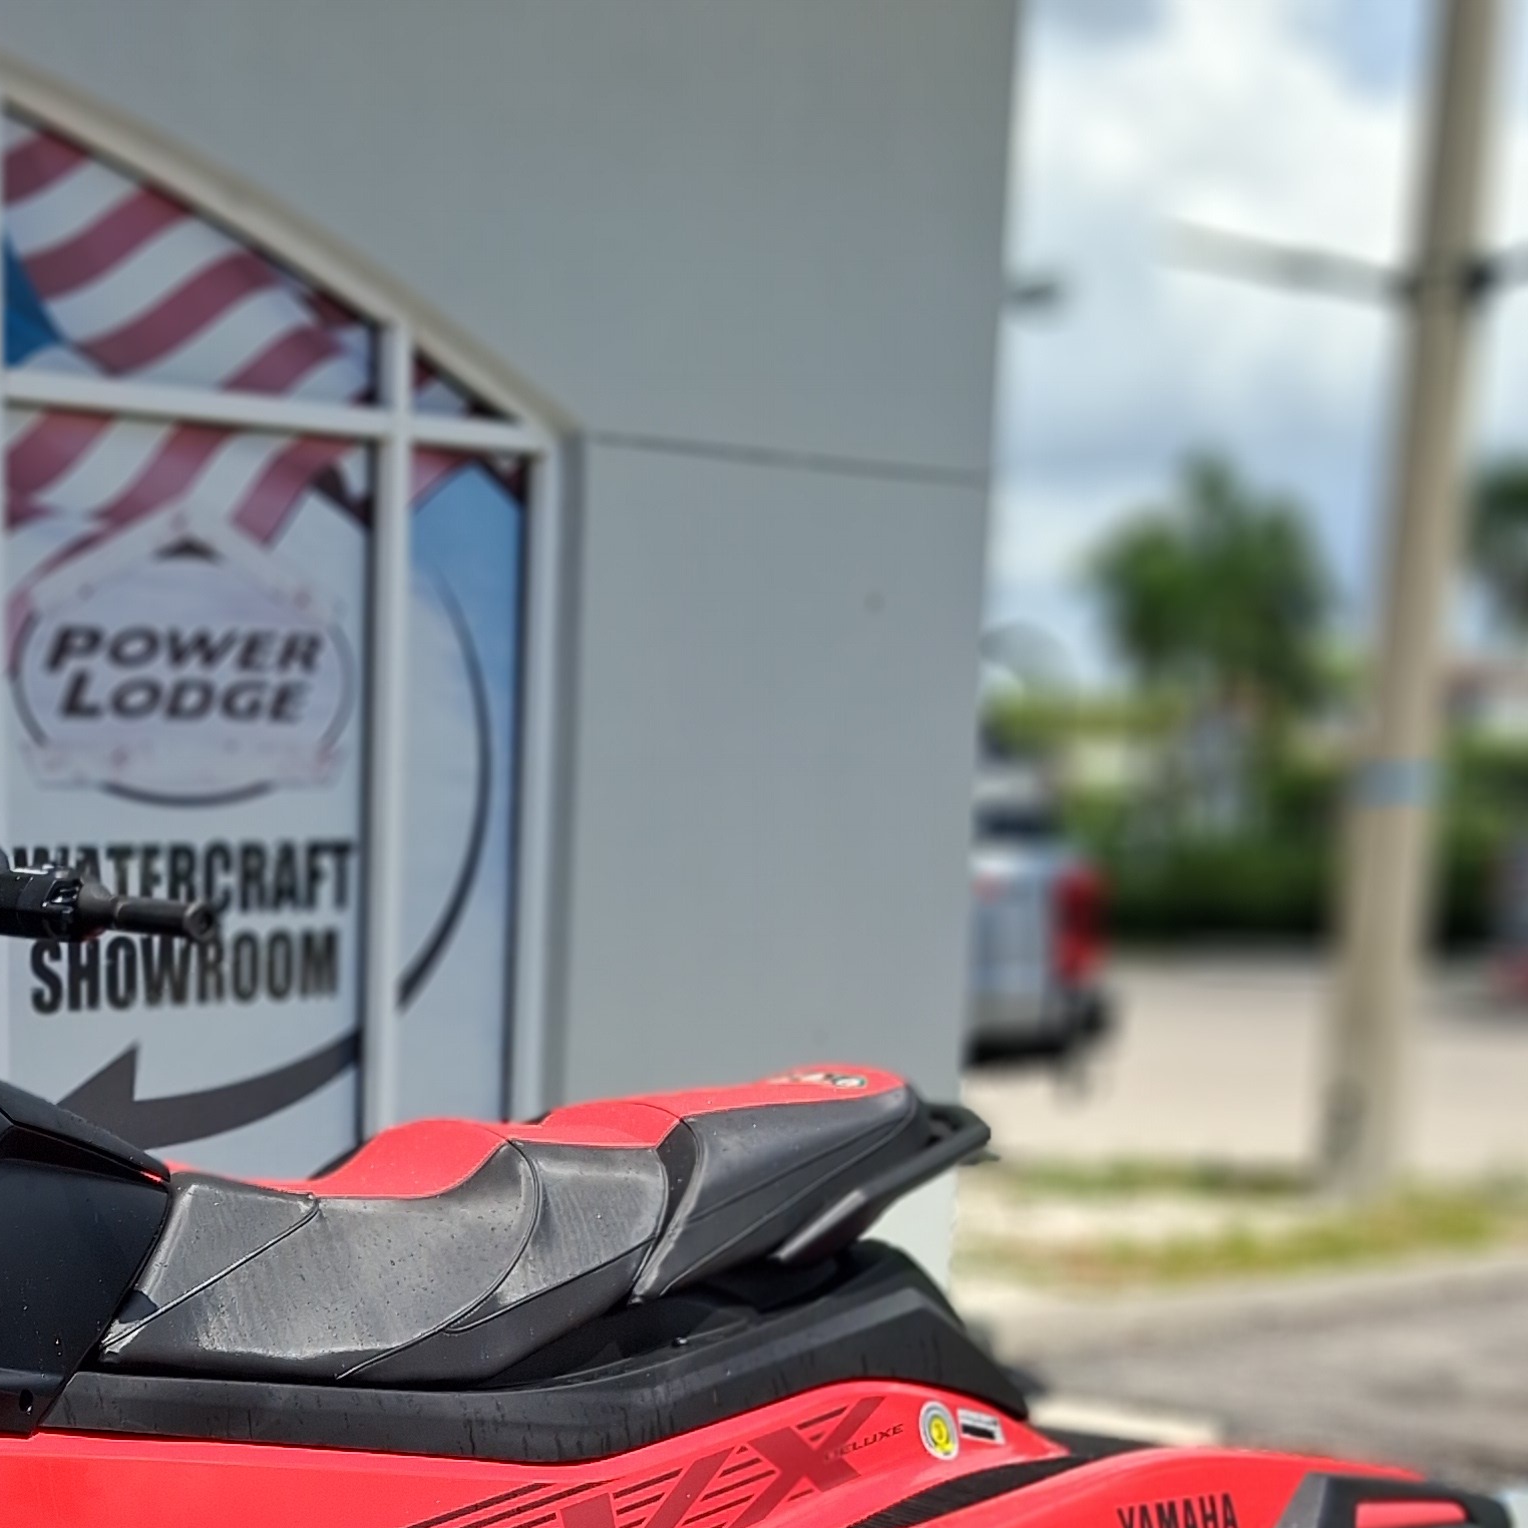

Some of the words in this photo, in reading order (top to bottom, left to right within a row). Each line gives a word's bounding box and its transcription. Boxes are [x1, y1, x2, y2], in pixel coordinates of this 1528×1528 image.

[45, 624, 322, 673] POWER
[60, 668, 310, 723] LODGE
[30, 926, 340, 1015] SHOWROOM
